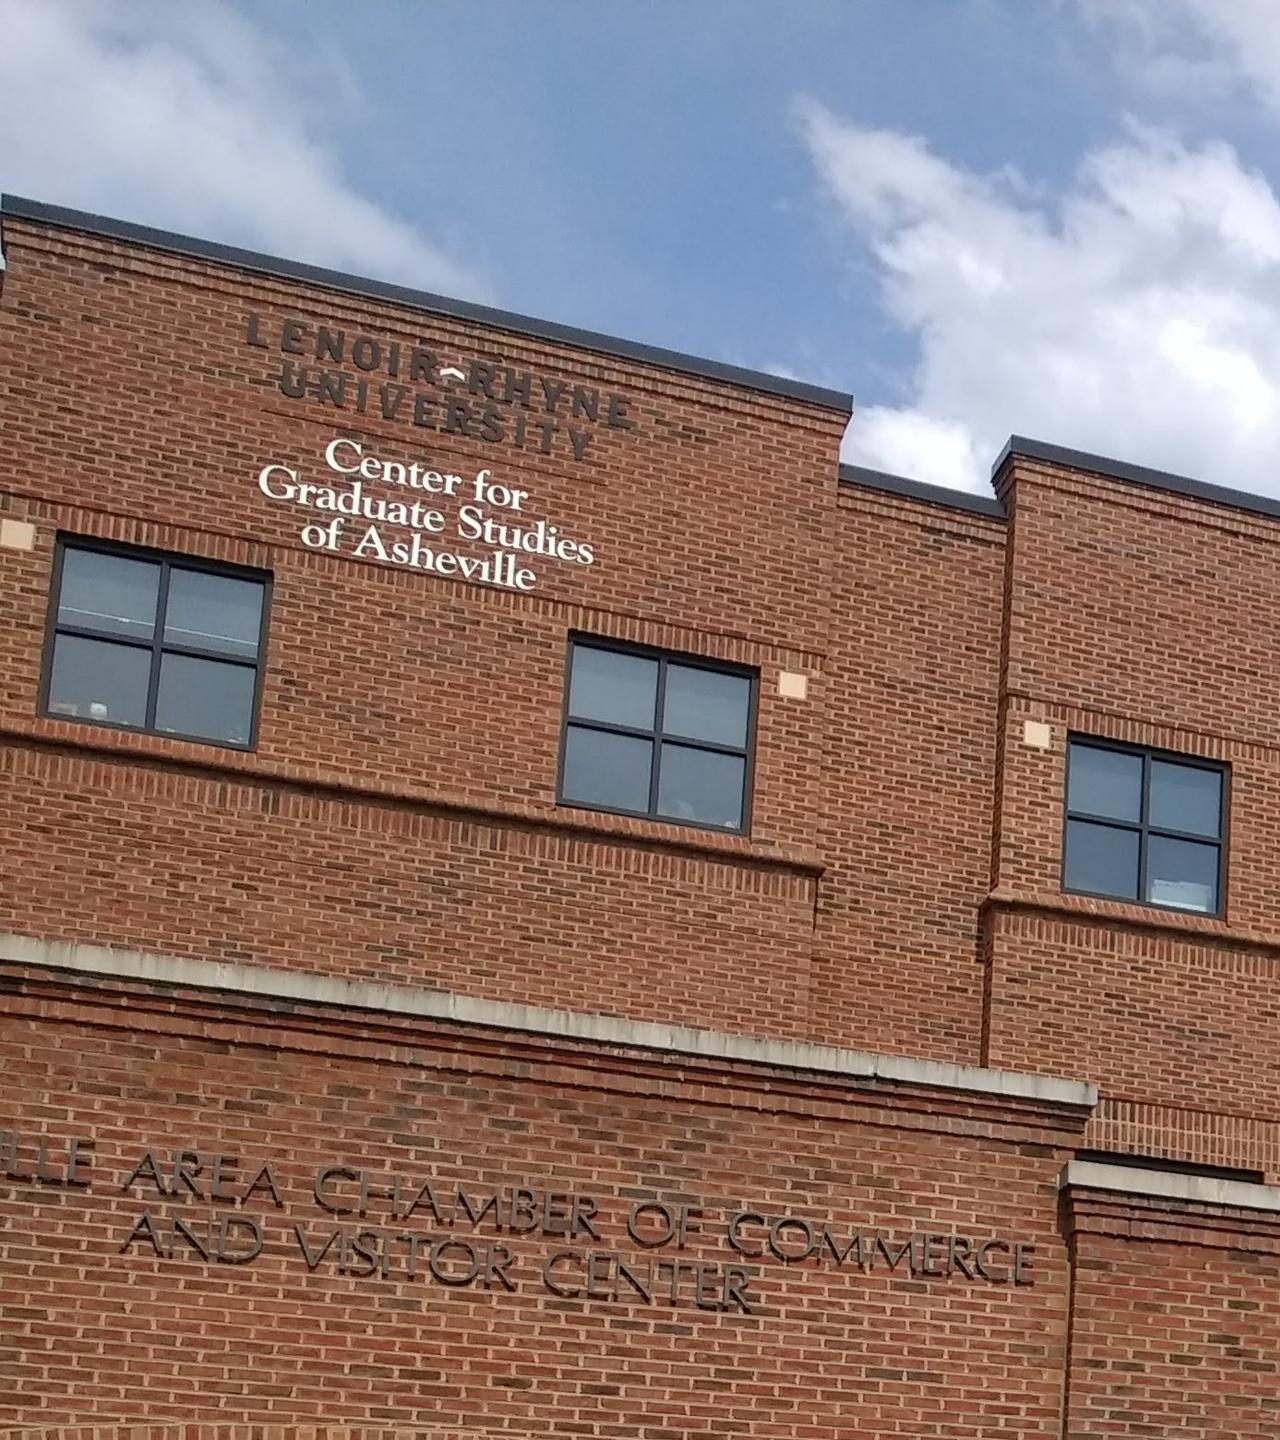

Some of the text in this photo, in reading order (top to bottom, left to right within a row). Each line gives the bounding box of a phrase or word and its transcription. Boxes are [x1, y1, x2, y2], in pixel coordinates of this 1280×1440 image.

[279, 358, 592, 460] UNIVERSITY
[258, 464, 595, 565] Graduate Studies
[325, 438, 528, 511] Center for
[301, 518, 537, 592] of Asheville
[119, 1209, 754, 1314] AND VISITOR CENTER
[121, 1150, 284, 1208] AREA
[313, 1166, 602, 1241] CHAMBER
[627, 1201, 703, 1249] OF
[728, 1211, 1036, 1288] COMMERCE
